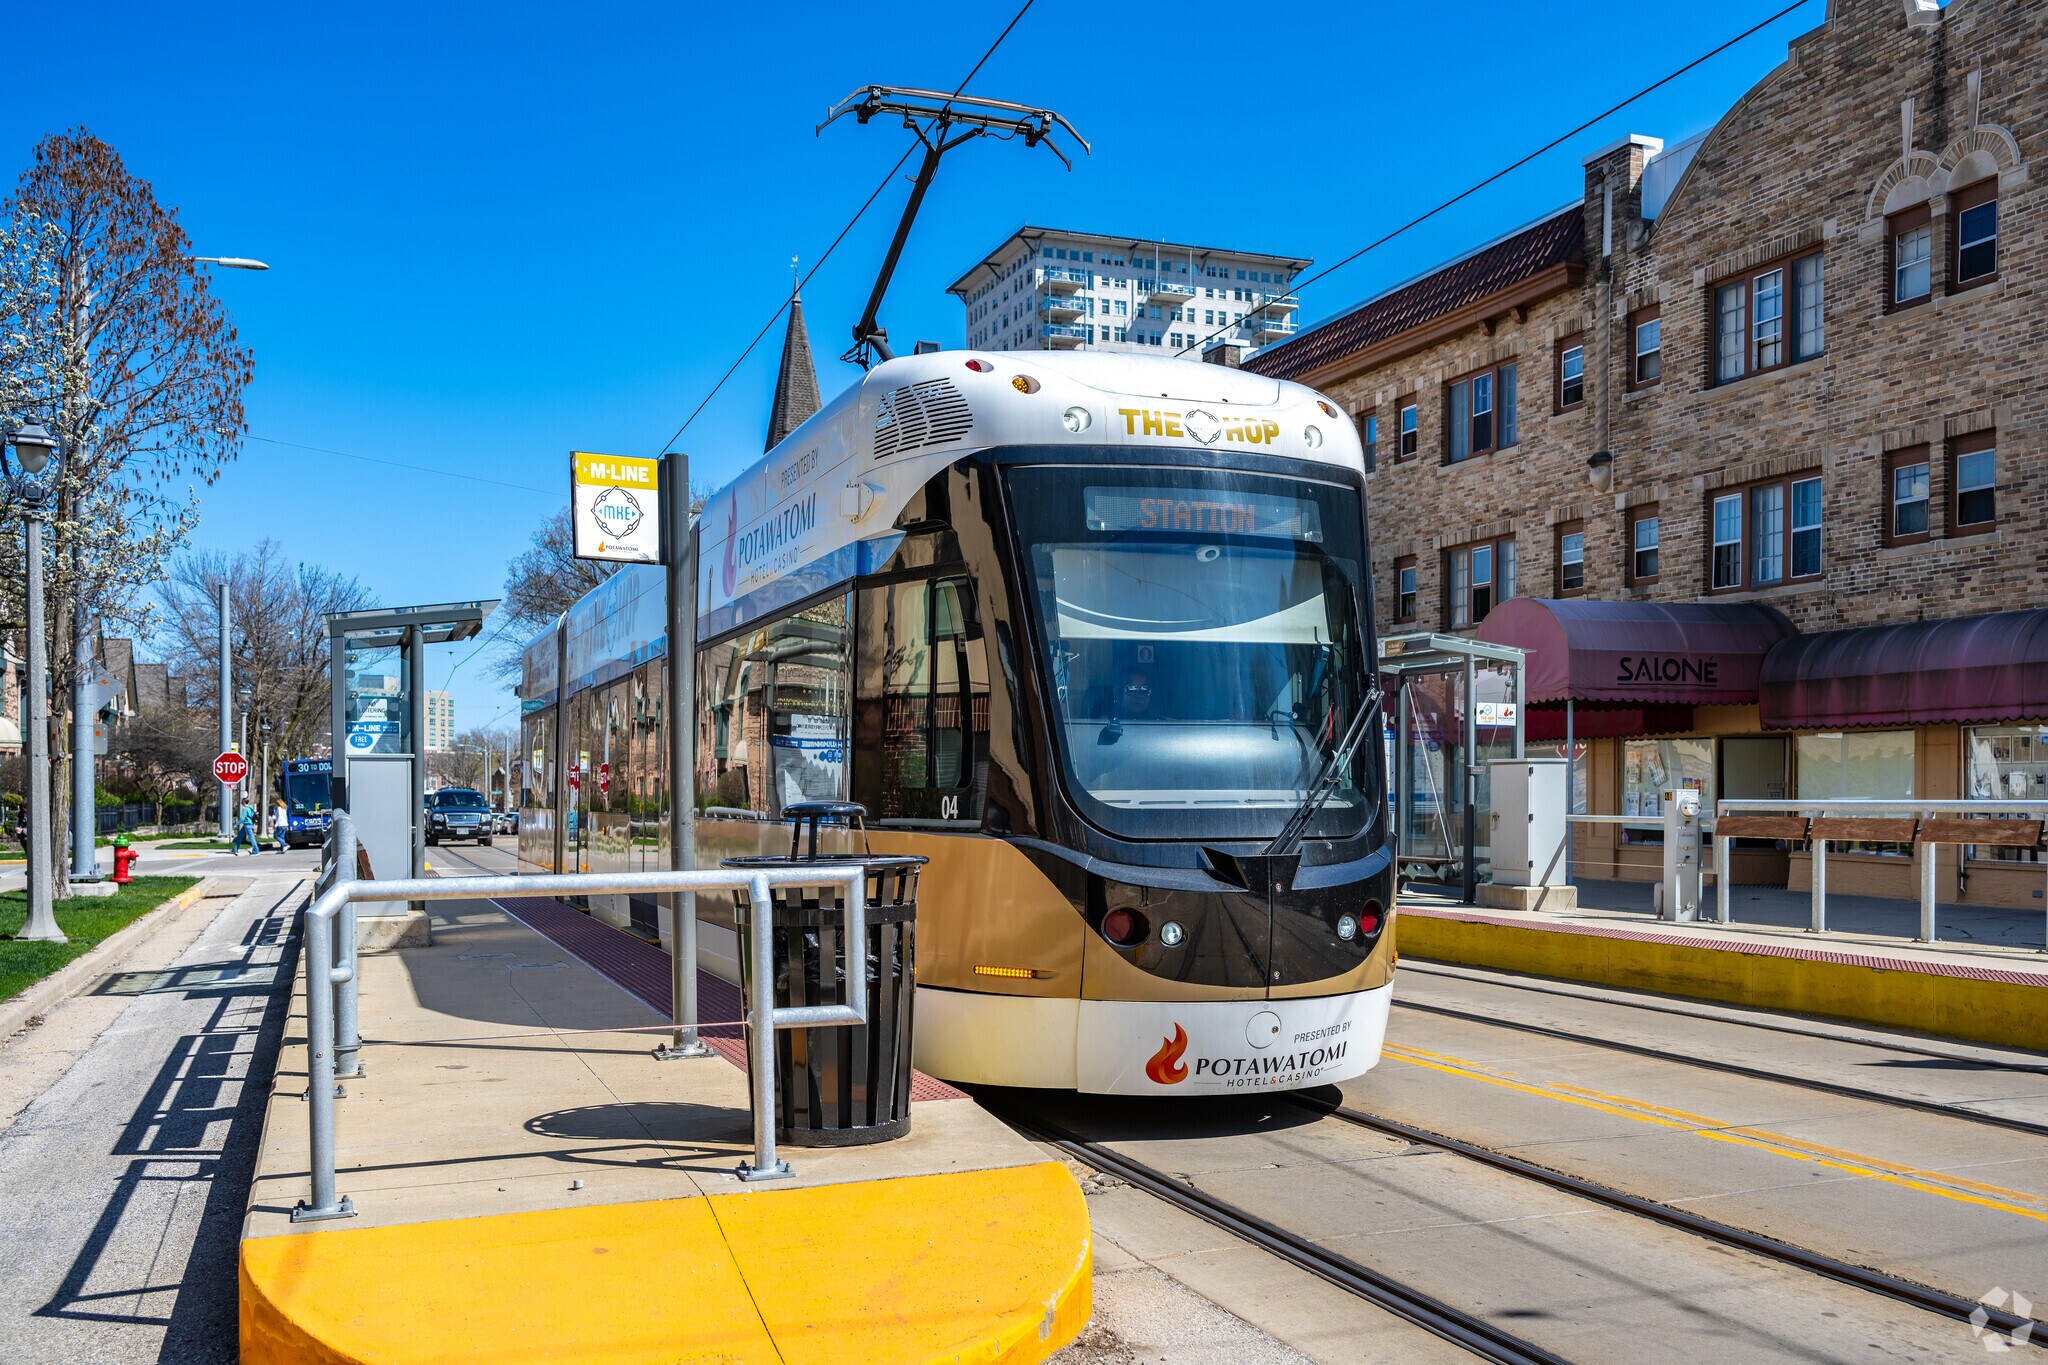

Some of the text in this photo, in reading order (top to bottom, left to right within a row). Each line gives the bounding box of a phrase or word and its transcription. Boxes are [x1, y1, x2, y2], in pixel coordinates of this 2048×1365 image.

[1118, 408, 1280, 445] THE HOP
[781, 447, 819, 490] PRESENTED BY
[603, 505, 631, 520] MKE
[1140, 498, 1255, 533] STATION
[739, 492, 816, 568] POTAWATOMI
[216, 762, 246, 774] STOP
[298, 763, 309, 772] 30
[941, 795, 958, 820] 04
[1293, 1021, 1352, 1043] PRESENTED BY
[1195, 1041, 1347, 1076] POTAWATOMI
